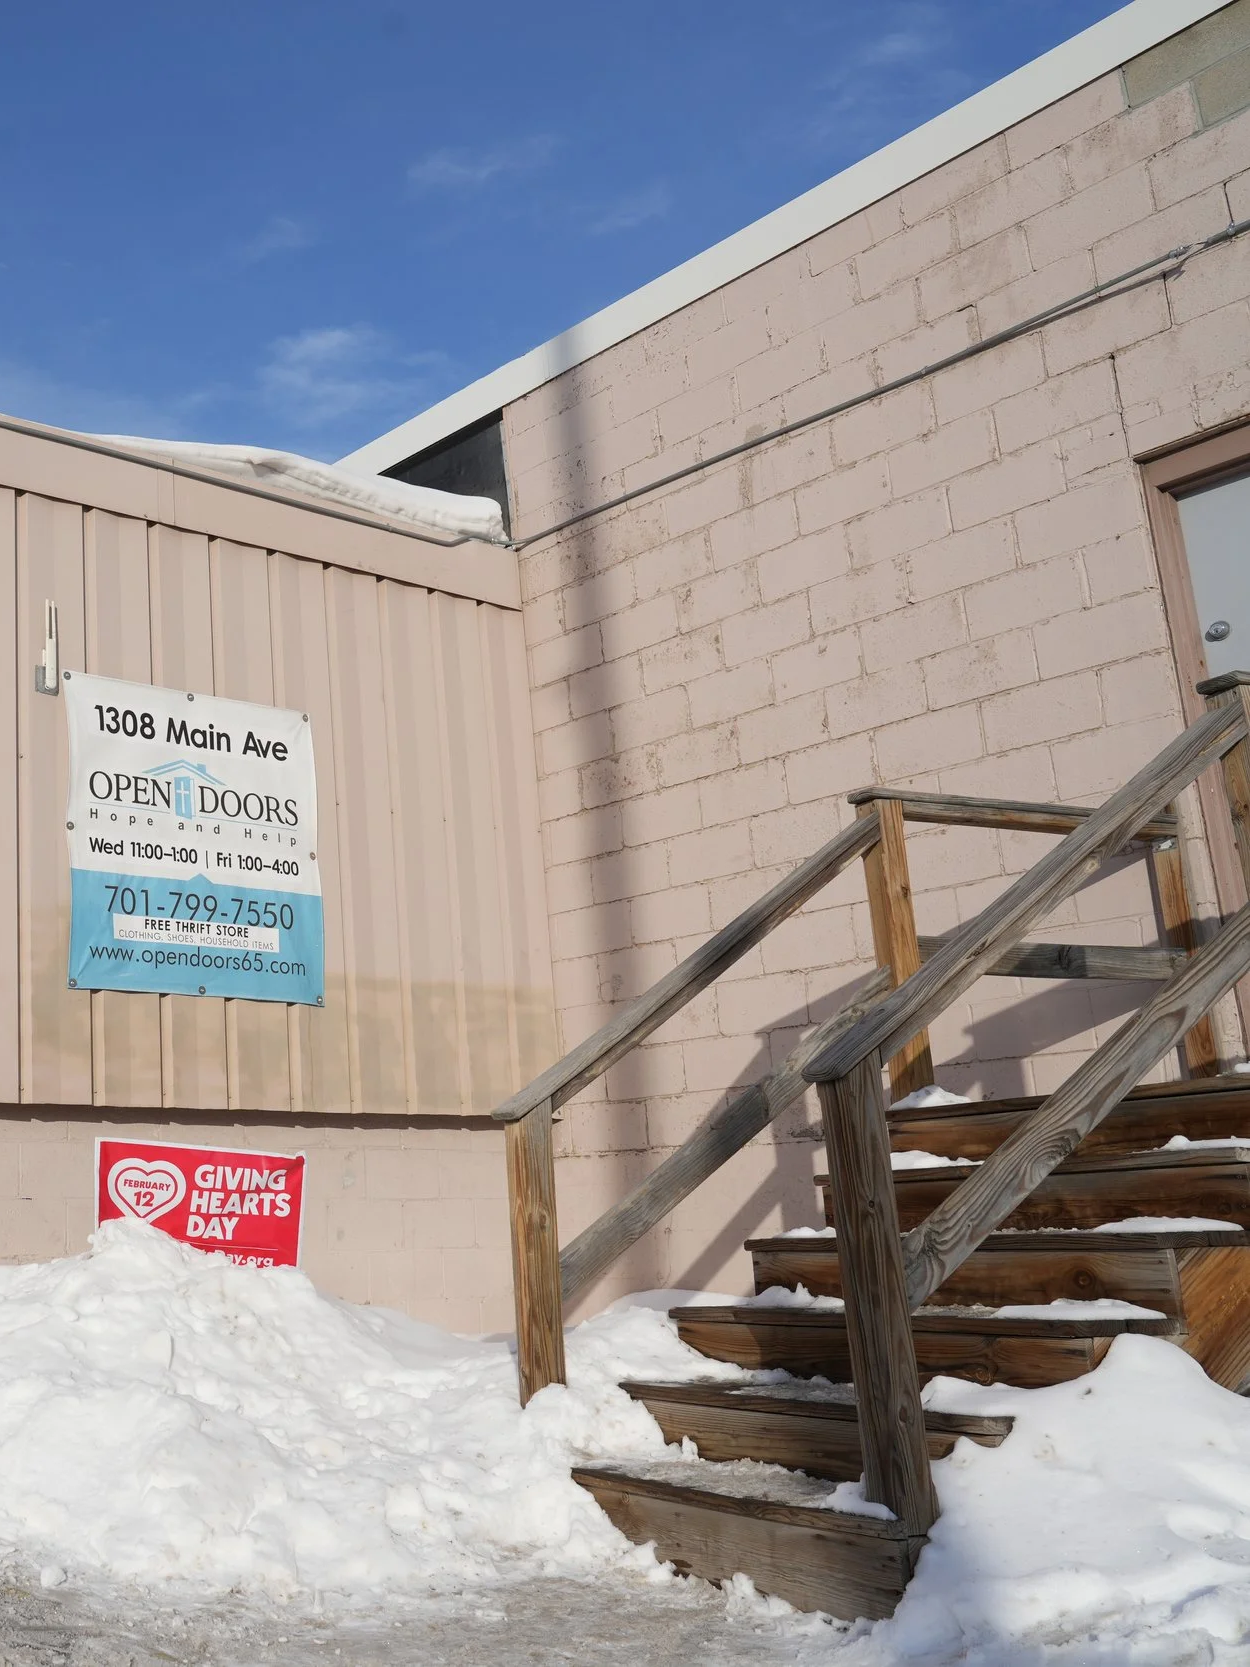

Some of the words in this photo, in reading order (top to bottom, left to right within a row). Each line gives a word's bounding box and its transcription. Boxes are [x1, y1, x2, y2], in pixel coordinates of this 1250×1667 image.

[94, 704, 156, 740] 1308
[166, 717, 231, 753] Main
[242, 731, 288, 762] Ave
[89, 770, 172, 809] OPEN
[199, 785, 298, 827] DOORS
[90, 808, 154, 827] Hope
[178, 820, 221, 836] and
[244, 828, 297, 847] Help
[89, 837, 124, 856] Wed
[216, 852, 233, 869] Fri
[104, 885, 294, 930] 701-799-7550
[144, 918, 171, 931] FREE
[175, 921, 212, 935] THRIFT
[216, 924, 249, 938] STORE
[200, 936, 249, 949] HOUSEHOLD
[252, 941, 275, 951] ITEMS
[90, 945, 306, 977] www.opendoors65.com
[123, 1179, 171, 1192] FEBRUARY
[194, 1164, 287, 1191] GIVING
[133, 1191, 155, 1207] 12
[189, 1189, 291, 1217] HEARTS
[186, 1215, 239, 1241] DAY
